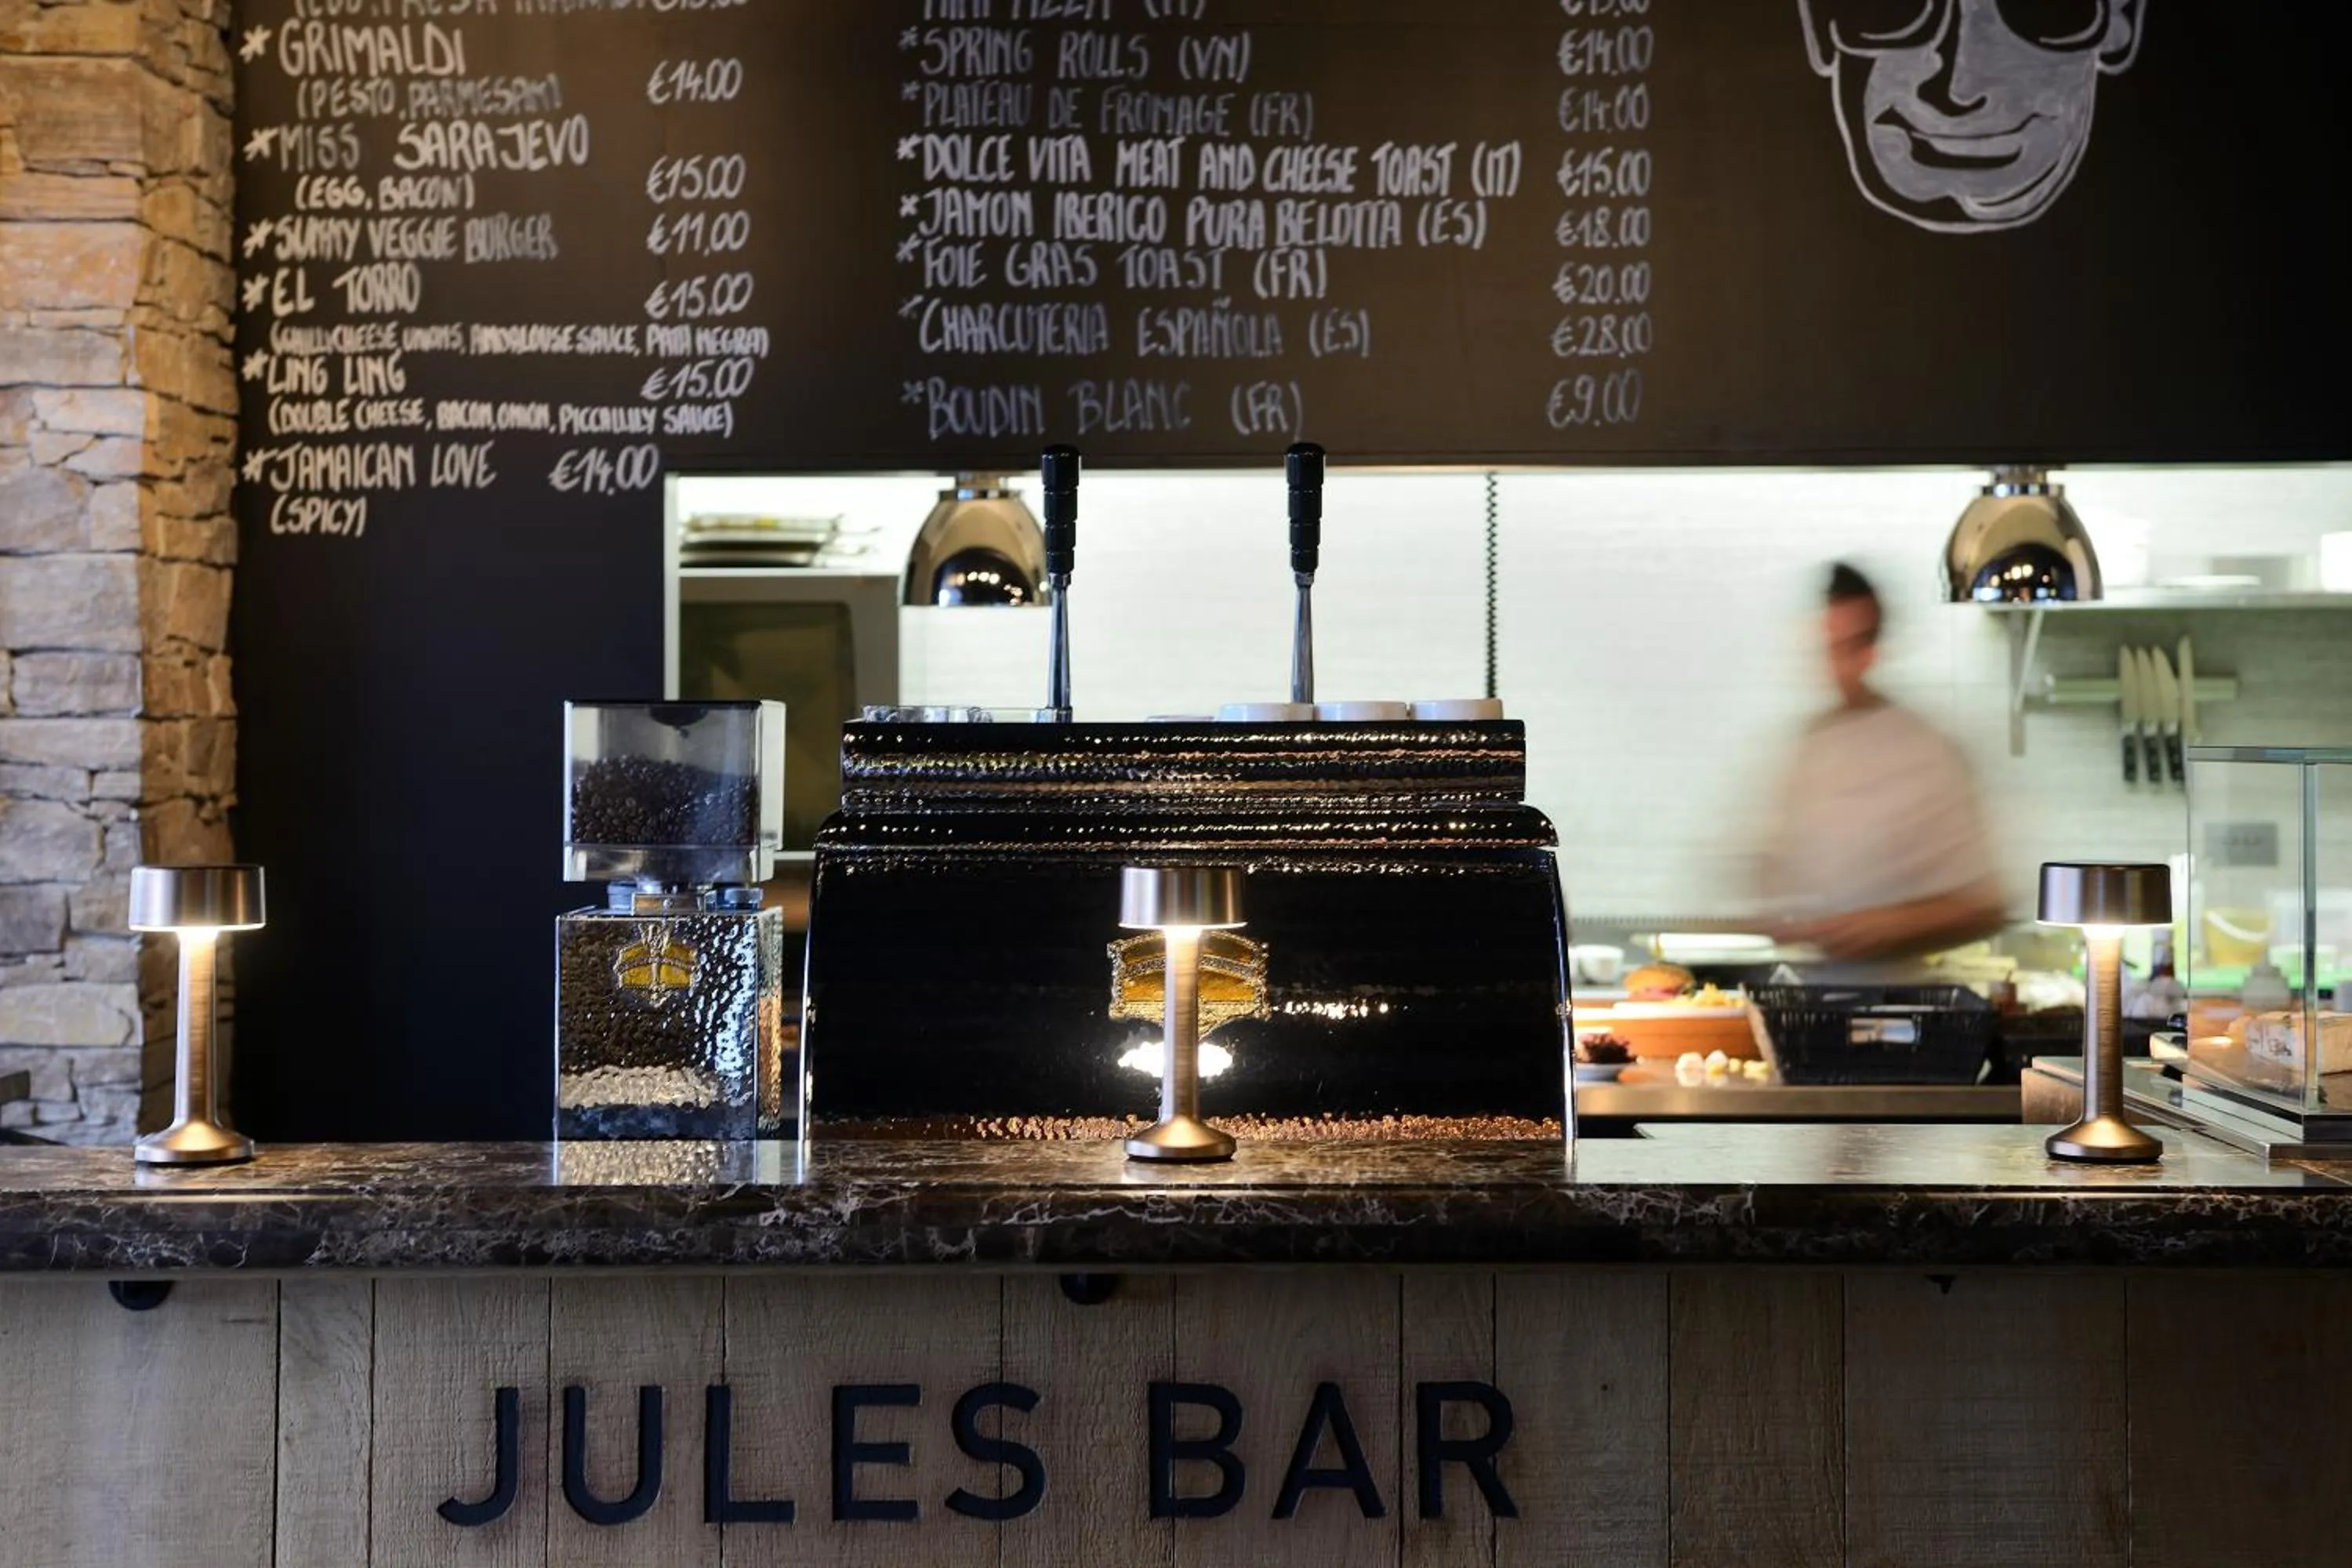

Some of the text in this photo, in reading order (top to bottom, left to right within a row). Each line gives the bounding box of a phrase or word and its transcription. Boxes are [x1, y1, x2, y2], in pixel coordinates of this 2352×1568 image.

[279, 19, 466, 77] GRIMALDI
[920, 27, 1251, 84] SPRING ROLLS (VN)
[1557, 25, 1655, 75] €14.00
[647, 57, 744, 104] €14.00
[924, 80, 1314, 141] PLATEAU DE FROMAGE (FR)
[278, 114, 590, 172] MISS SARAJEVO
[923, 134, 1522, 198] DOLCE VITA MEAT AND CHEESE TOAST (IT)
[378, 172, 475, 212] BACON)
[367, 214, 459, 260] VEGGIE
[464, 212, 559, 263] BURGER
[919, 187, 1033, 238] JAMON
[1054, 191, 1167, 242] IBERICO
[1186, 195, 1265, 249] PURA
[1417, 198, 1487, 250] (ES)
[1555, 206, 1650, 249] €18.00
[272, 264, 421, 314] EL TORRO
[923, 237, 1327, 299] FOIE GRAS TOAST (FR)
[1552, 261, 1651, 305] €20.00
[644, 271, 753, 319] €15.00
[919, 297, 1370, 358] CHARCUTERIA ESPAÑOLA (ES)
[267, 350, 406, 394] LING LING
[641, 356, 755, 401] €15.00
[268, 394, 350, 436] (DOUBLE
[927, 376, 1304, 441] BOUDIN BLANC (FR)
[269, 441, 495, 492] JAMAICAN LOVE
[548, 444, 659, 495] €14.00
[270, 495, 367, 537] (SPICY)
[436, 1381, 1519, 1526] JULES BAR
